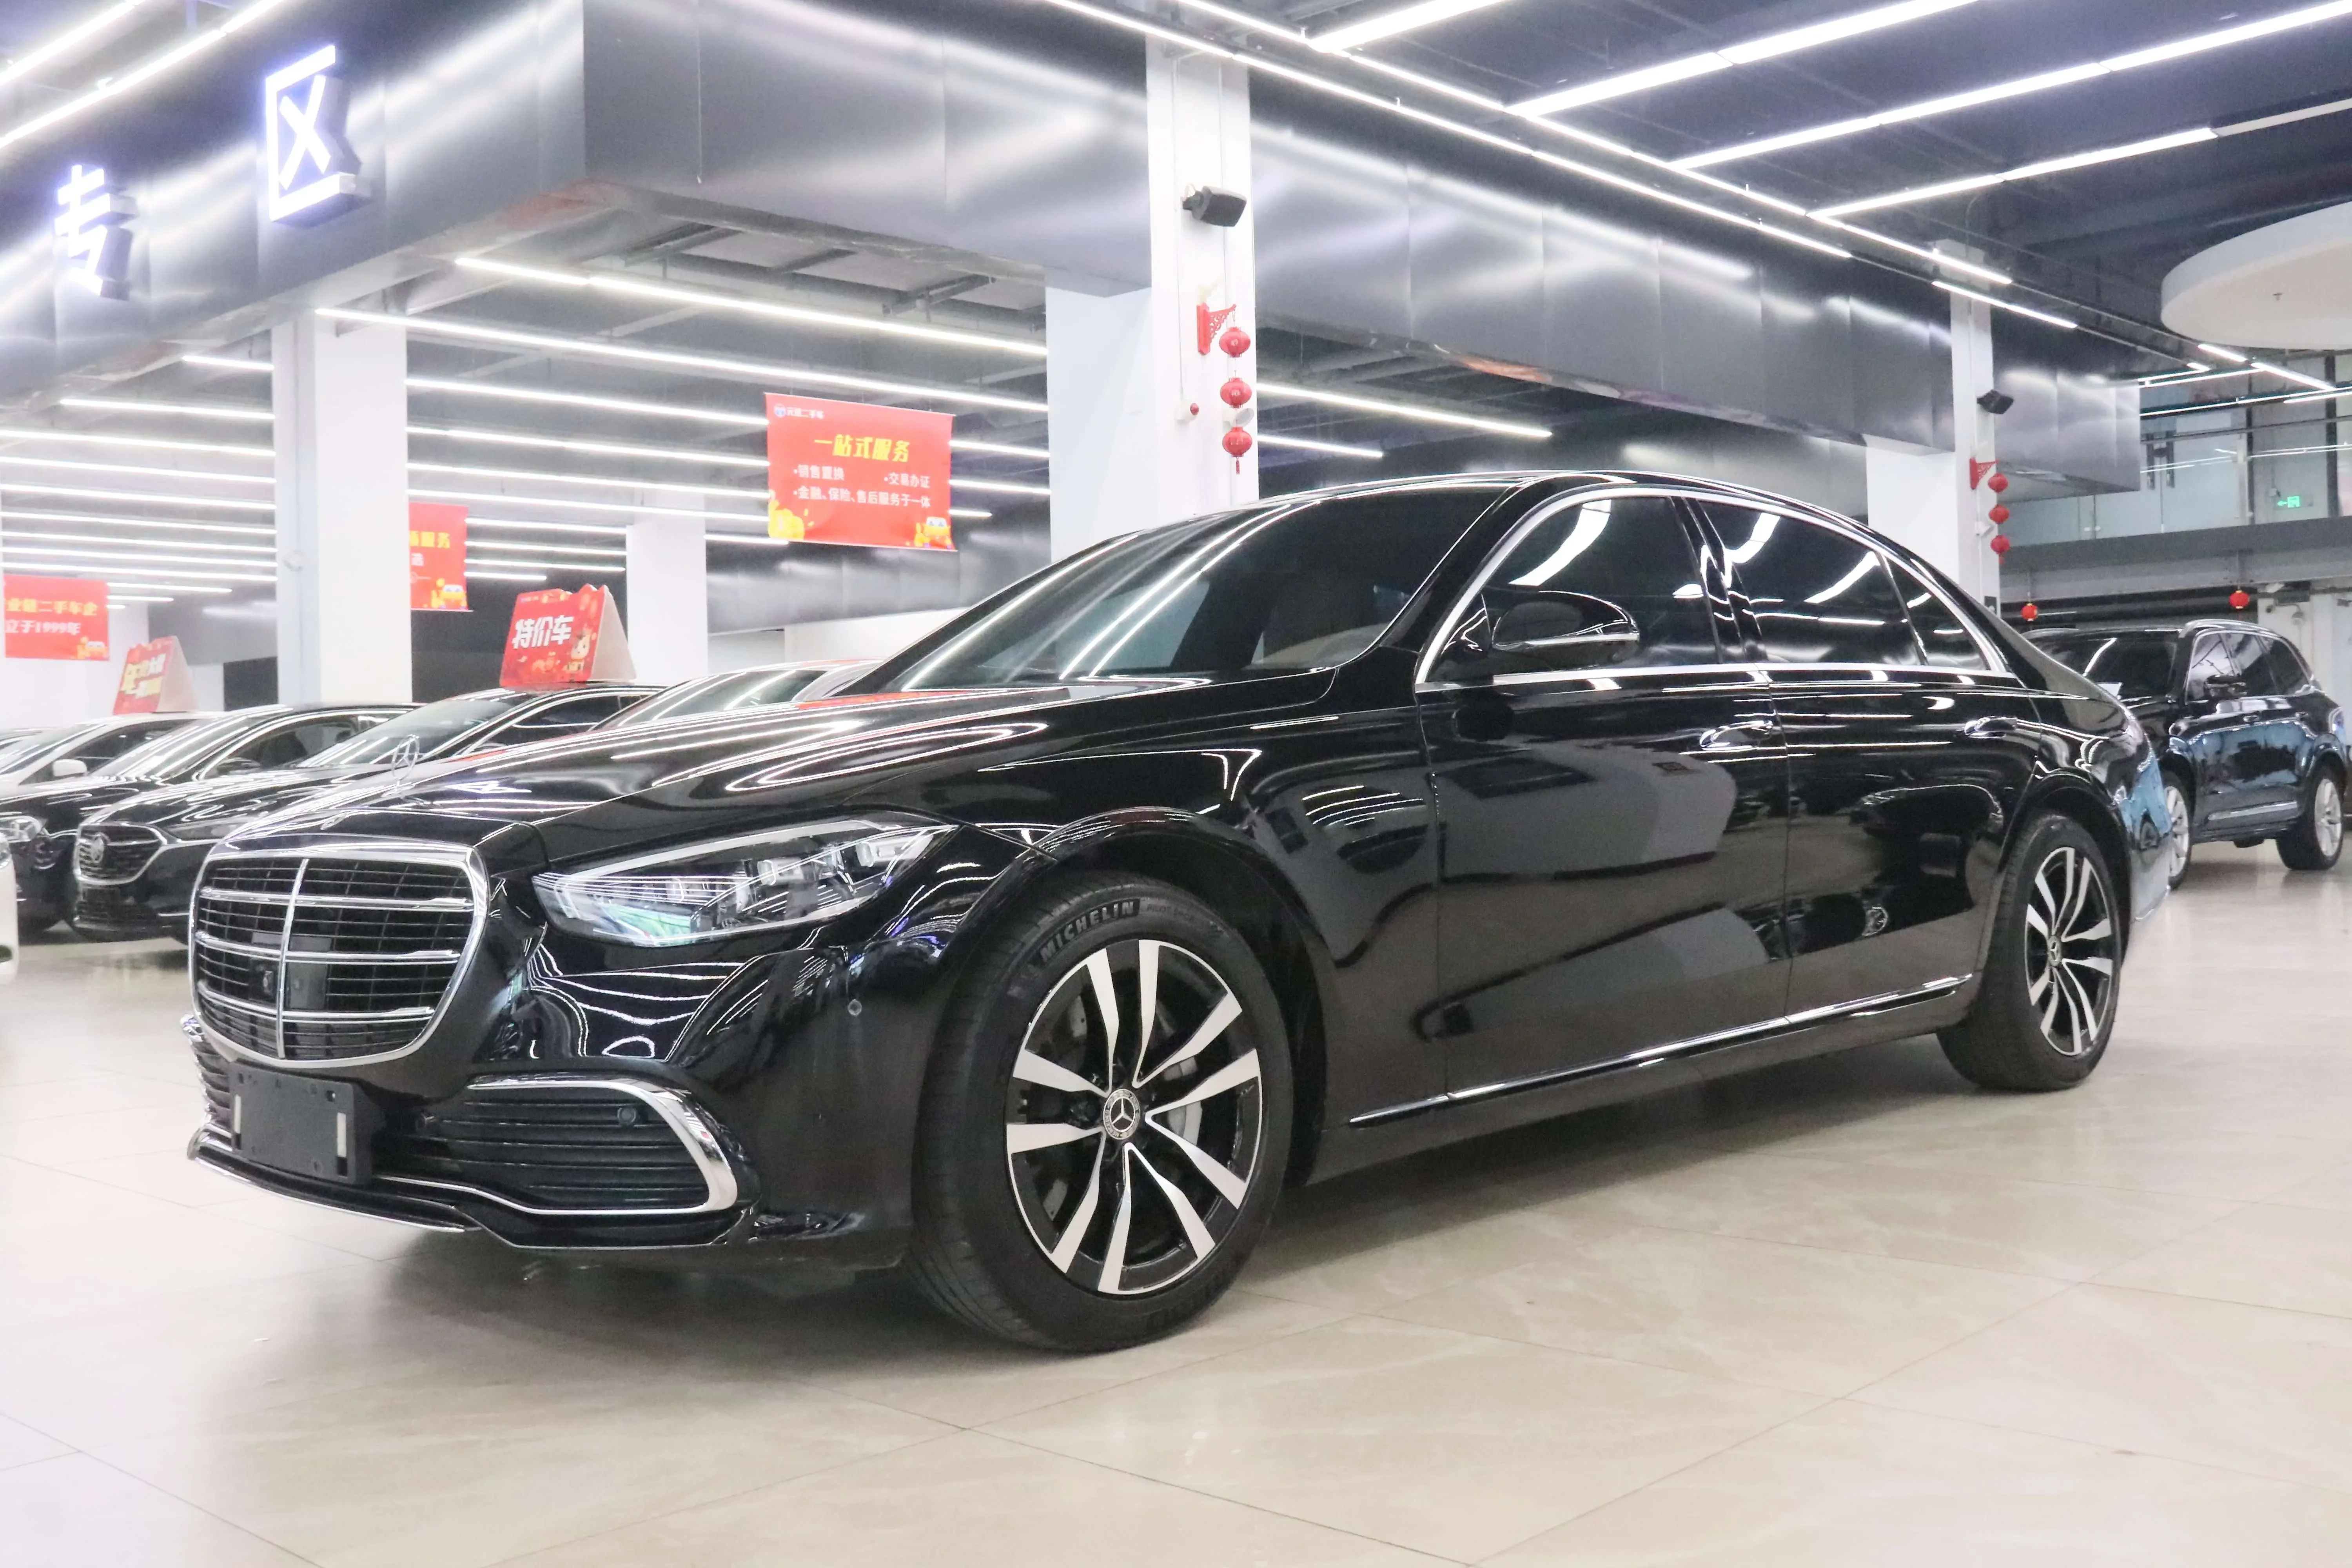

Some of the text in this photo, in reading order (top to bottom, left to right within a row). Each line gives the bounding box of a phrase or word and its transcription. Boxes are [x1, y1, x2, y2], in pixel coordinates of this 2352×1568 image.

[54, 44, 345, 297] 专区
[814, 434, 910, 463] 一站式服务
[797, 464, 845, 481] 销售置换
[888, 472, 931, 489] 交易办证
[512, 615, 574, 649] 特价车
[1147, 904, 1171, 912] PILOT
[1040, 901, 1134, 963] MICHELIN
